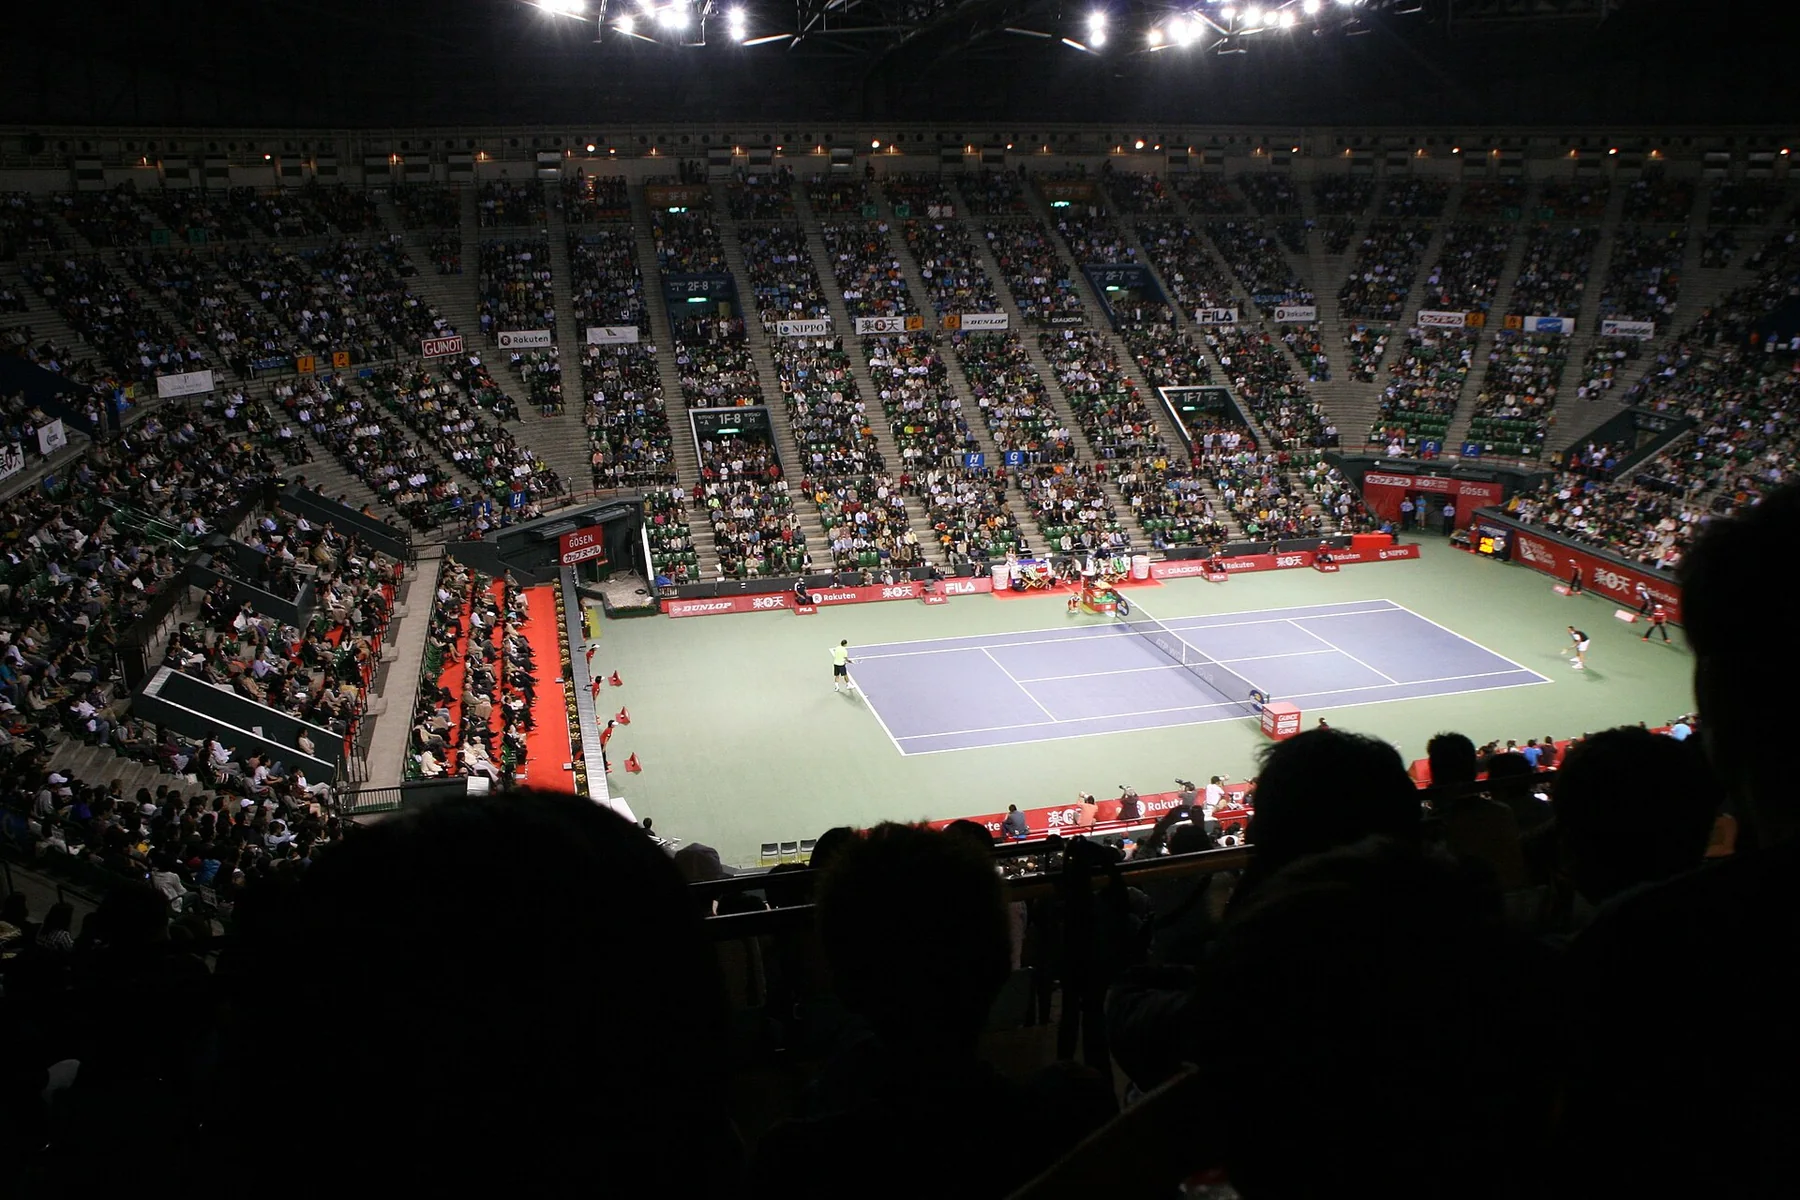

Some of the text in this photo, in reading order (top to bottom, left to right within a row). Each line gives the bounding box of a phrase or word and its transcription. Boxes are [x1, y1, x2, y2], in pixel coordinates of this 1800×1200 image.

[1106, 271, 1125, 281] 2F-7
[688, 281, 709, 291] 2F-8
[1202, 311, 1233, 322] FILA
[793, 323, 825, 333] NIPPO
[513, 336, 549, 344] Rakuten
[424, 339, 461, 355] GUINOT
[1183, 391, 1202, 402] 1F-7
[719, 413, 742, 425] 1F-8
[970, 454, 980, 463] H
[1010, 452, 1019, 461] G
[1460, 486, 1490, 497] GOSEN
[513, 493, 522, 504] H
[569, 534, 593, 548] GOSEN
[1226, 561, 1256, 570] Rakuten
[945, 581, 976, 595] FILA
[823, 593, 856, 602] Rakuten
[683, 602, 732, 612] DUNLOP
[1148, 795, 1185, 811] Rakut
